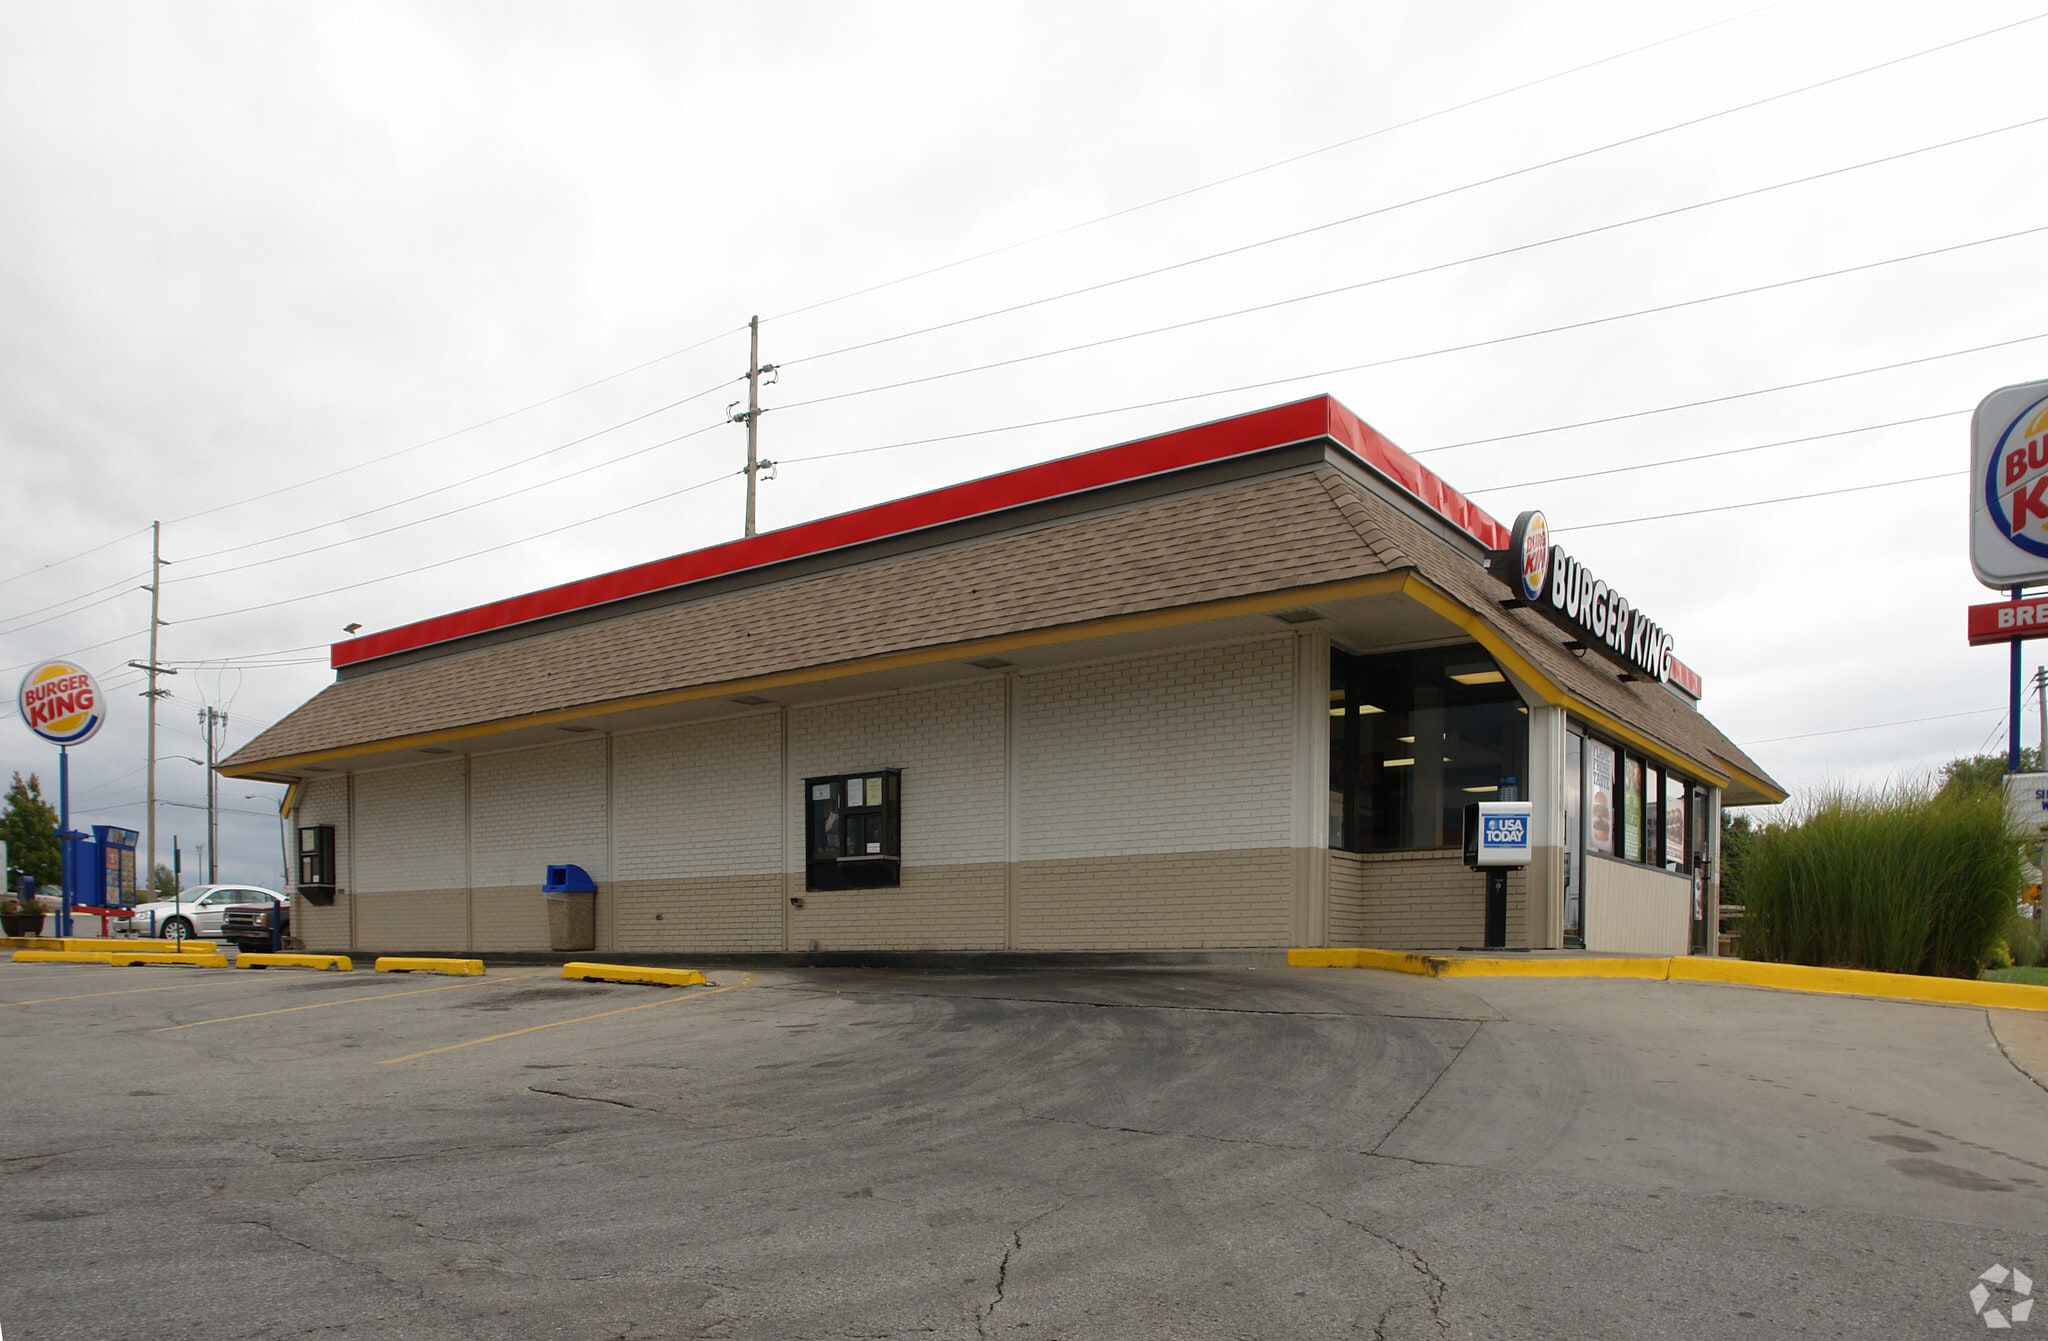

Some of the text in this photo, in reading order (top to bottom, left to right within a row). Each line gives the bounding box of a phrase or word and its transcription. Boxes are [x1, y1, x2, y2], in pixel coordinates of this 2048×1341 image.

[1551, 545, 1674, 684] BURGER KING
[25, 674, 89, 707] BURGER
[30, 689, 94, 728] KING
[1592, 771, 1610, 790] TASTE
[2036, 789, 2048, 799] SI
[1498, 819, 1523, 831] USA
[1486, 830, 1525, 843] TODAY
